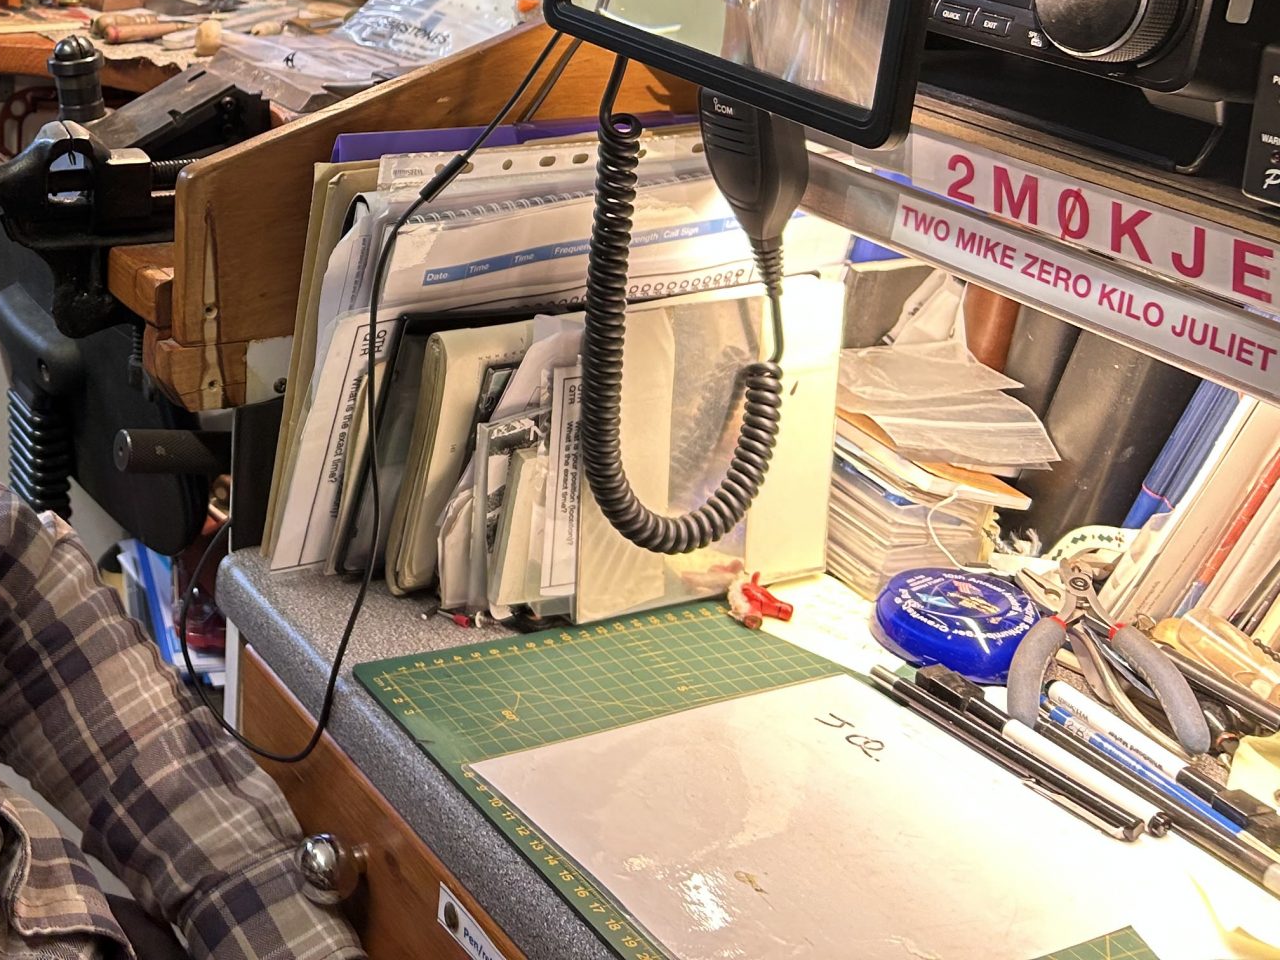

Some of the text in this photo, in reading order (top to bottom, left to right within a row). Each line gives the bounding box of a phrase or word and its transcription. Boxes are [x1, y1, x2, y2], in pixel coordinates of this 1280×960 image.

[942, 9, 961, 21] QUICK
[983, 19, 998, 30] EXIT
[425, 270, 449, 283] Date
[468, 262, 490, 274] Time
[512, 252, 535, 265] Time
[554, 242, 592, 258] Frequen
[663, 228, 680, 240] Call
[681, 225, 700, 239] Sign
[902, 204, 1278, 372] TWO MIKE ZERO KILO JULIET
[568, 384, 577, 405] QTR
[334, 431, 347, 458] exact
[565, 420, 574, 444] What
[328, 458, 341, 484] time?
[570, 472, 578, 503] position
[463, 770, 638, 948] 8 9 10 11 12 13 14 15 16 17 18 19
